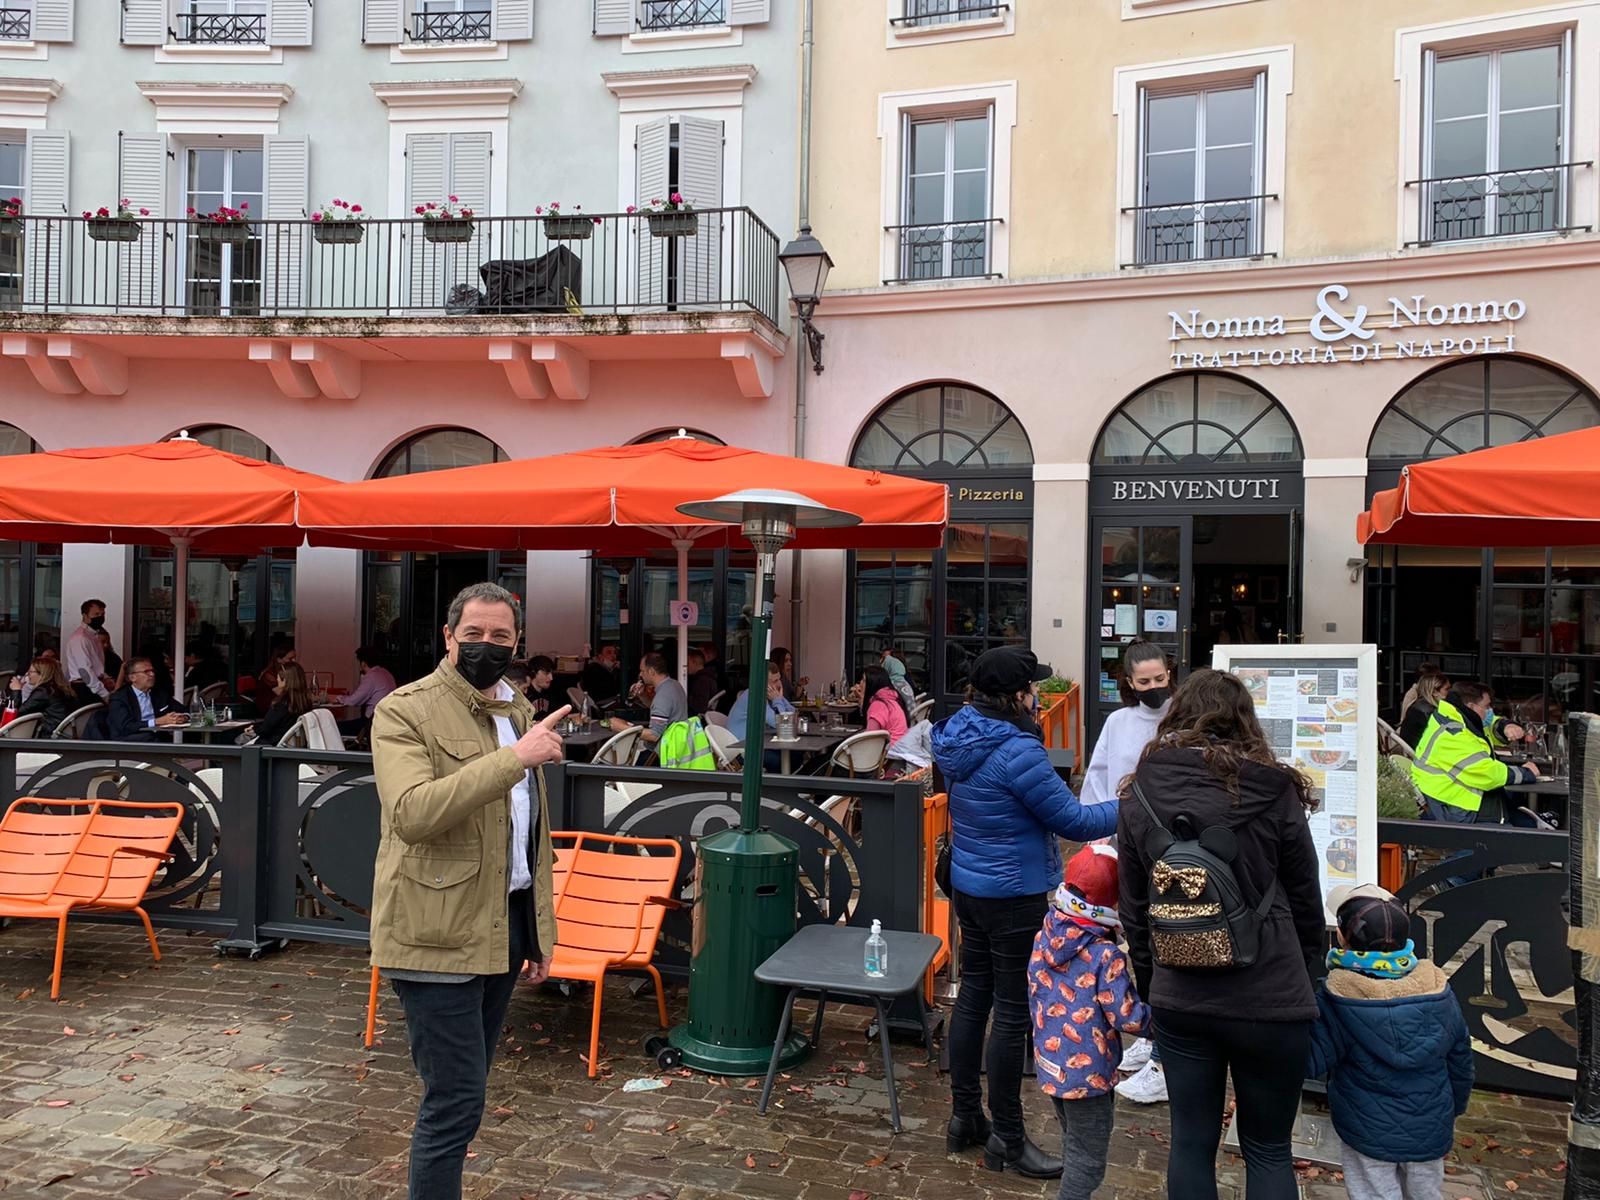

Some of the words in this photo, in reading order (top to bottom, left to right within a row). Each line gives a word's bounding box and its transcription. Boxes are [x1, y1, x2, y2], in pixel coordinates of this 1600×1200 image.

[1168, 310, 1286, 341] Nonna
[1309, 284, 1375, 342] &
[1387, 295, 1527, 329] Nonno
[1171, 346, 1339, 369] TRATTORIA
[1350, 343, 1382, 362] DI
[1395, 335, 1516, 358] NAPOLI
[959, 487, 1024, 501] Pizzeria
[1112, 479, 1279, 500] BENVENUTI
